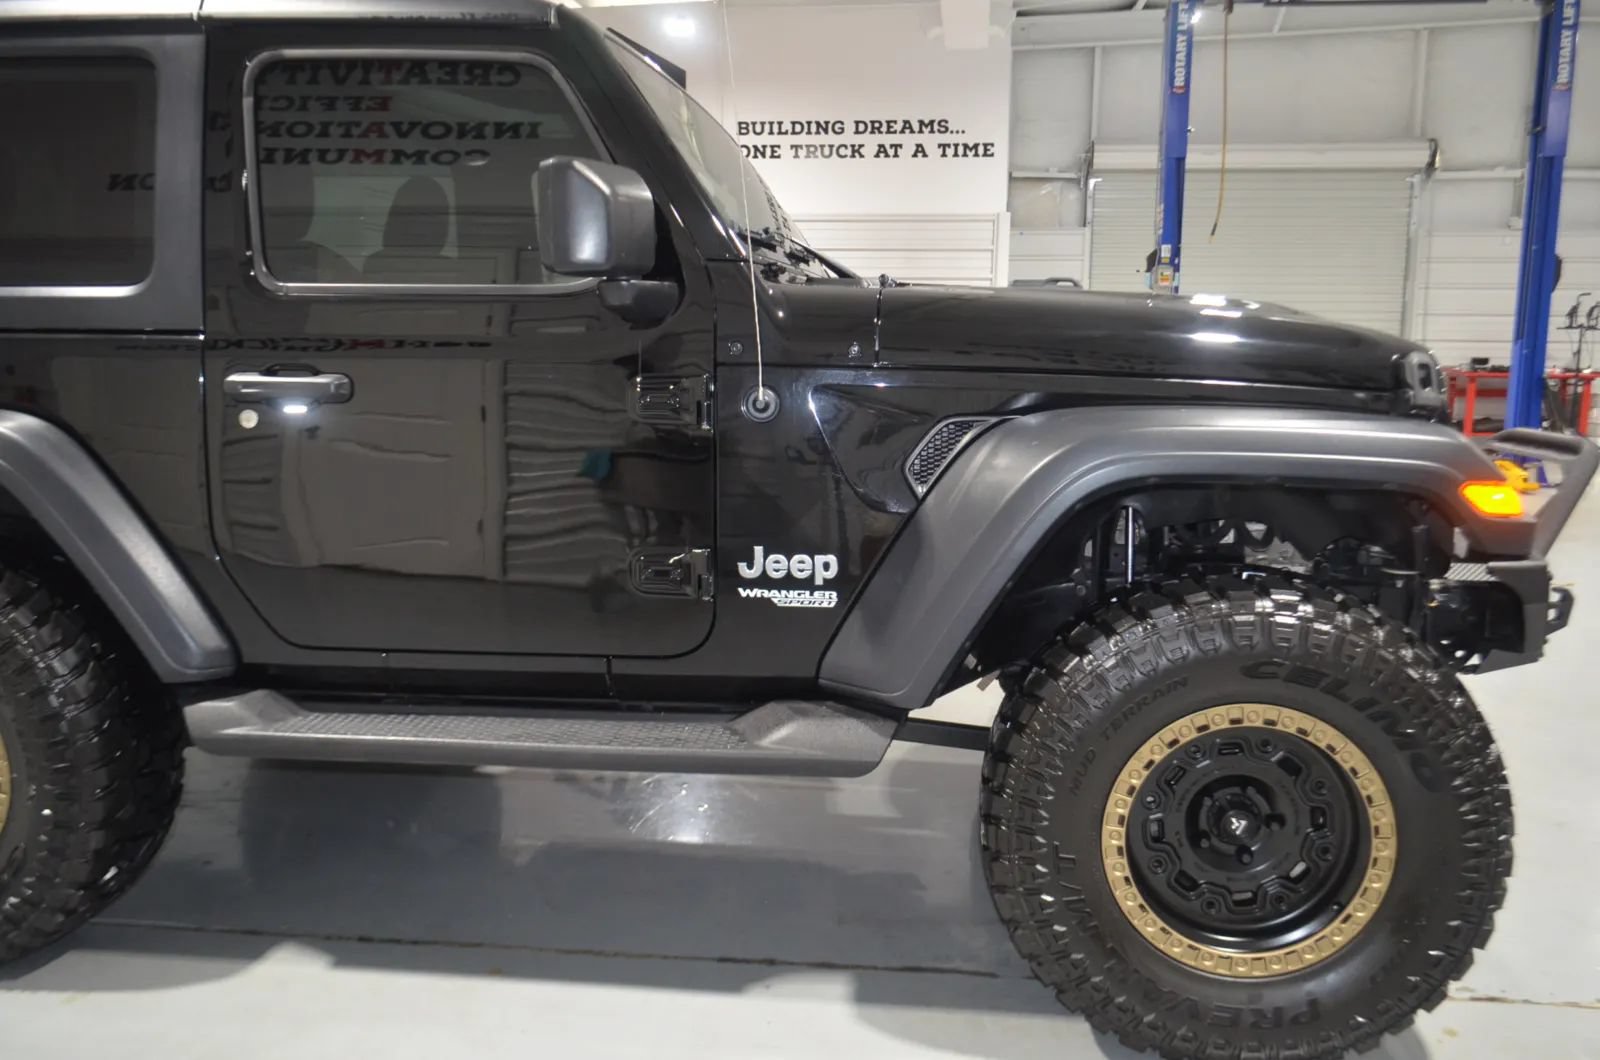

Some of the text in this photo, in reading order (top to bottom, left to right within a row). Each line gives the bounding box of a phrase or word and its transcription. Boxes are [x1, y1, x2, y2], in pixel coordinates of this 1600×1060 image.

[1174, 33, 1187, 87] ROTARY
[1556, 29, 1572, 85] ROTARY
[737, 119, 966, 136] BUILDING DREAMS...
[790, 143, 865, 160] TRUCK
[873, 143, 903, 158] AT
[911, 143, 928, 158] A
[937, 142, 995, 158] TIME
[737, 546, 838, 585] Jeep
[737, 588, 838, 599] WRANGLER
[775, 598, 836, 607] SPORT
[1070, 675, 1188, 797] MUD TERRAIN
